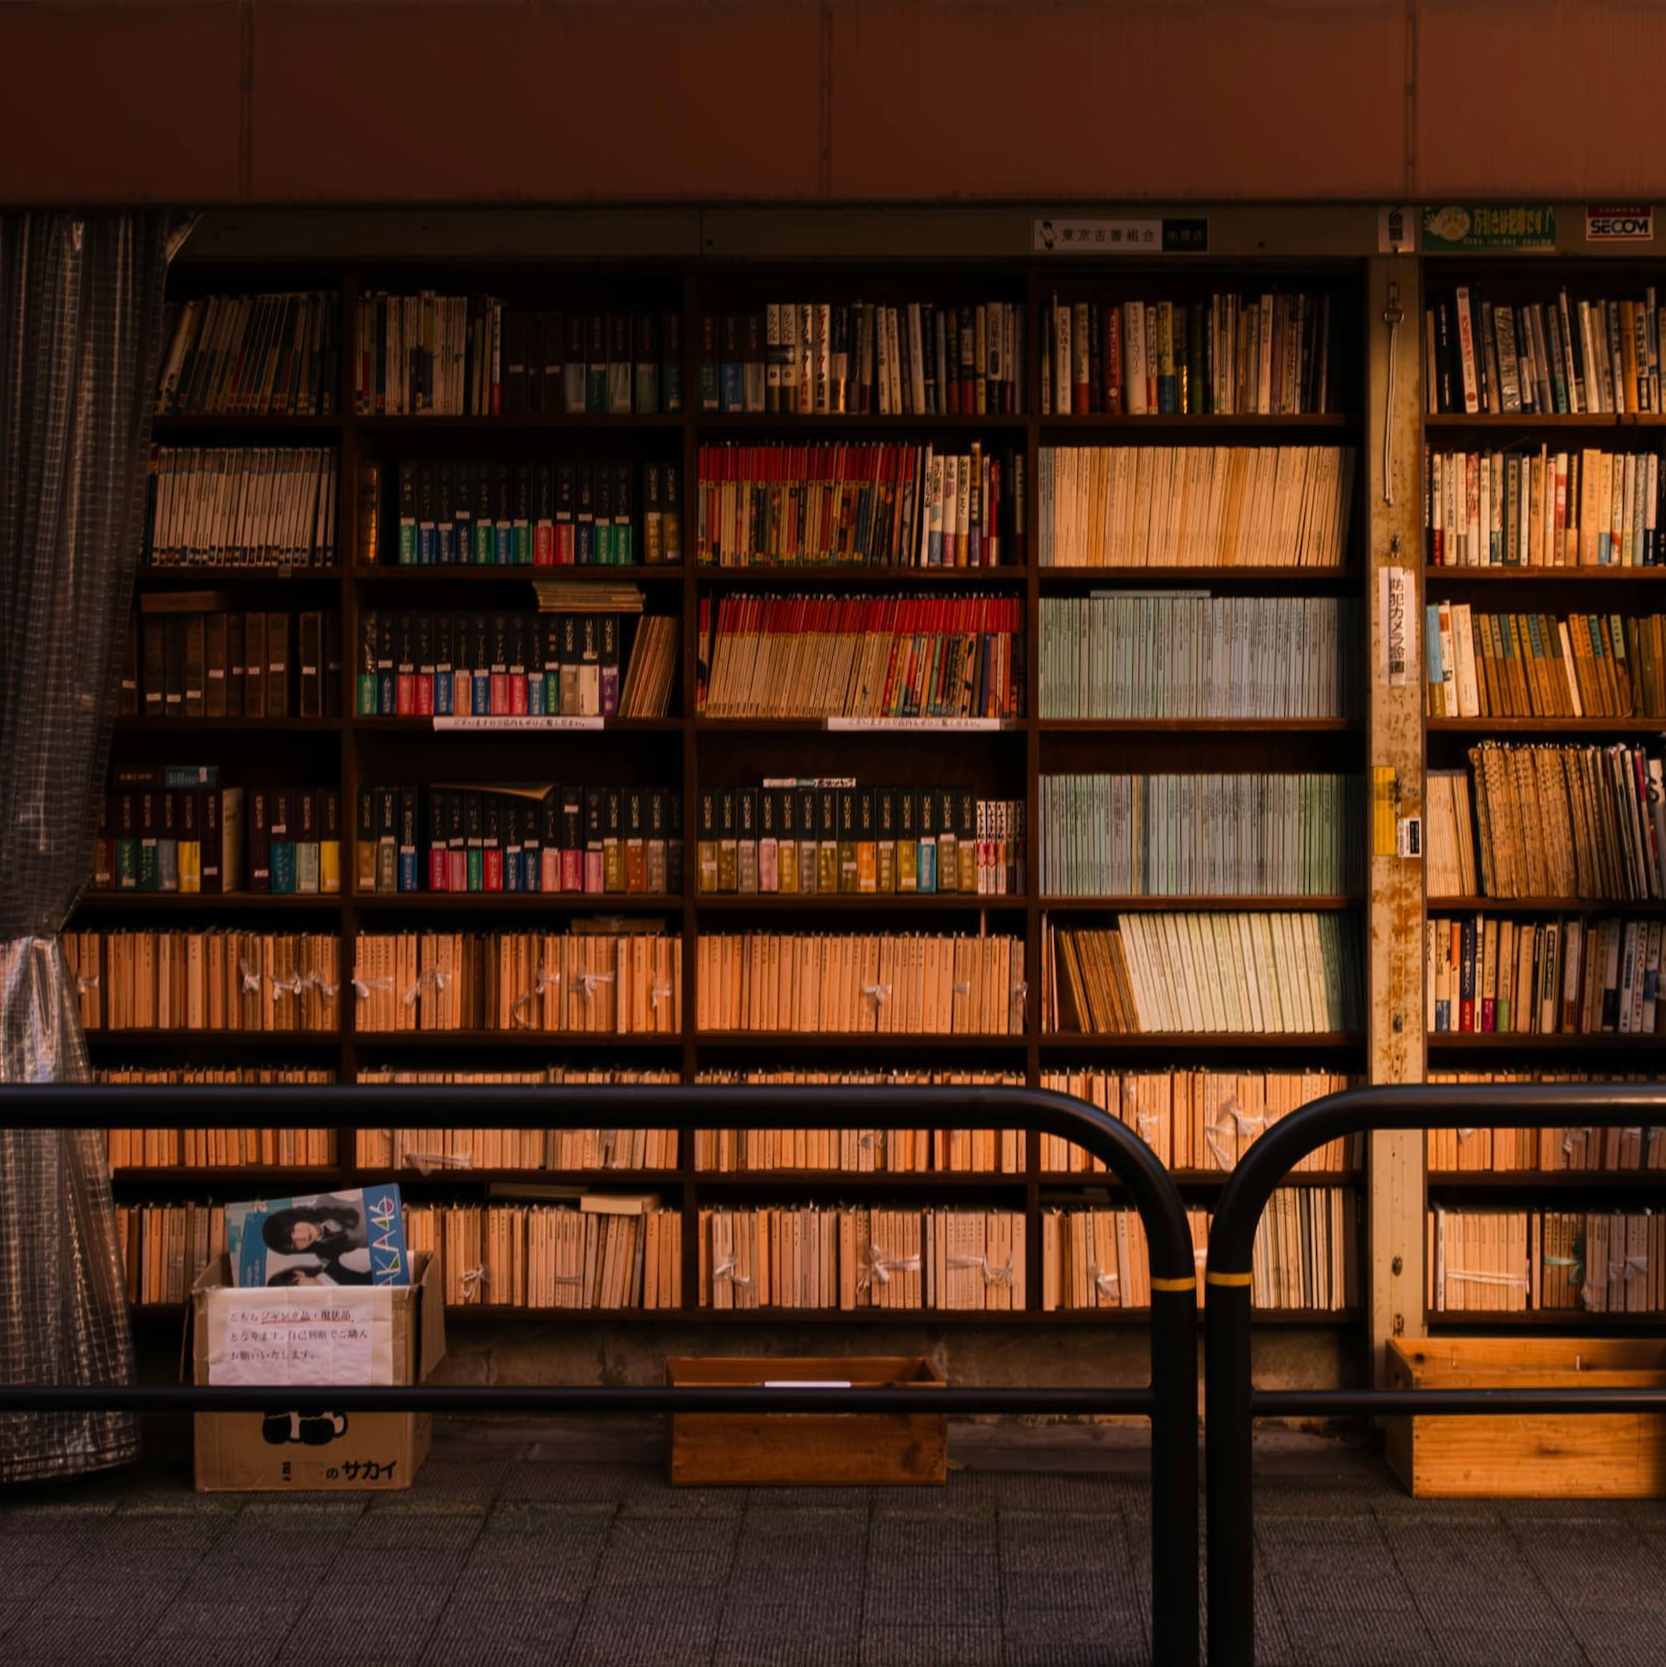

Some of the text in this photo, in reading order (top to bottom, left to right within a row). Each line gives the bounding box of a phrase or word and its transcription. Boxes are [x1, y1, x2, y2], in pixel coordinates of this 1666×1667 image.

[1590, 219, 1650, 234] SECOM
[326, 1459, 398, 1482] のサカイ
